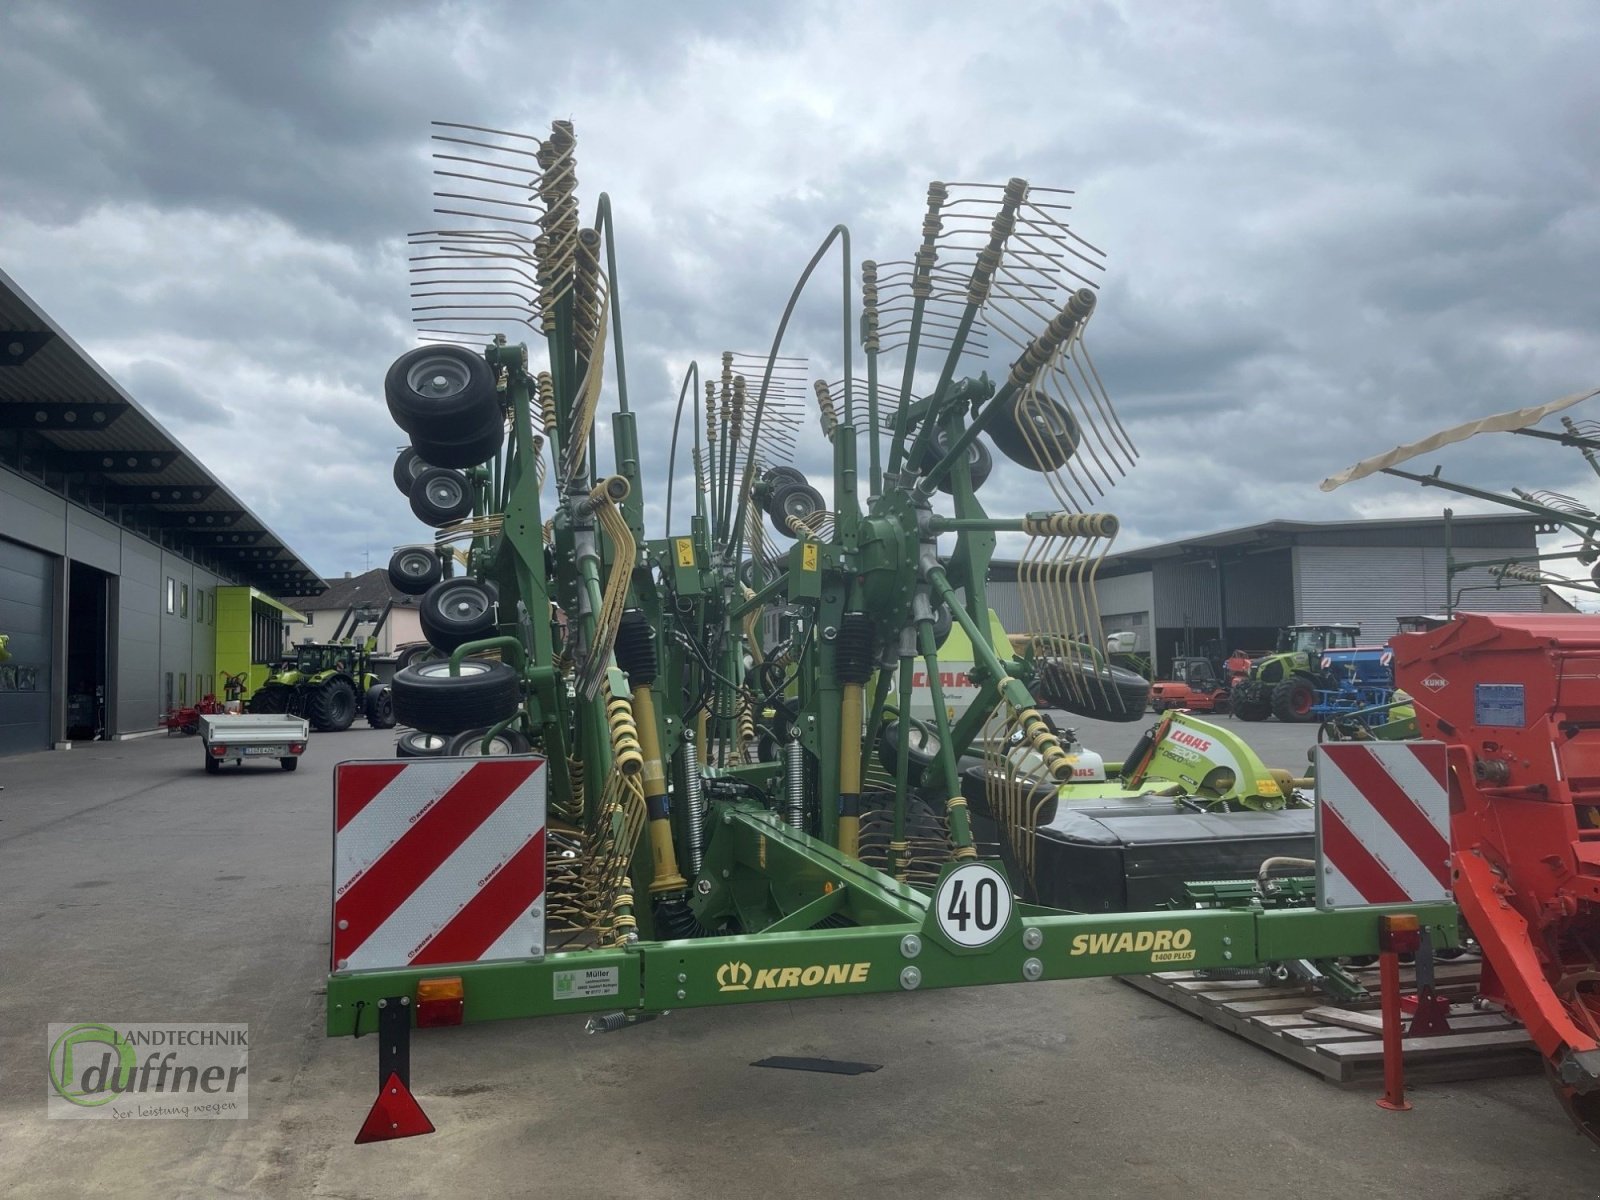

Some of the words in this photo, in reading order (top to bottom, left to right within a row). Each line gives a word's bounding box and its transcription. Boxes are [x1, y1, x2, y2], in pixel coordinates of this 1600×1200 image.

[912, 672, 973, 687] CLAA
[1170, 730, 1212, 752] CLAAS
[947, 877, 998, 931] 40
[1070, 929, 1192, 955] SWADRO
[1174, 951, 1192, 960] PLUS
[586, 970, 609, 978] Müller
[753, 962, 871, 989] KRONE
